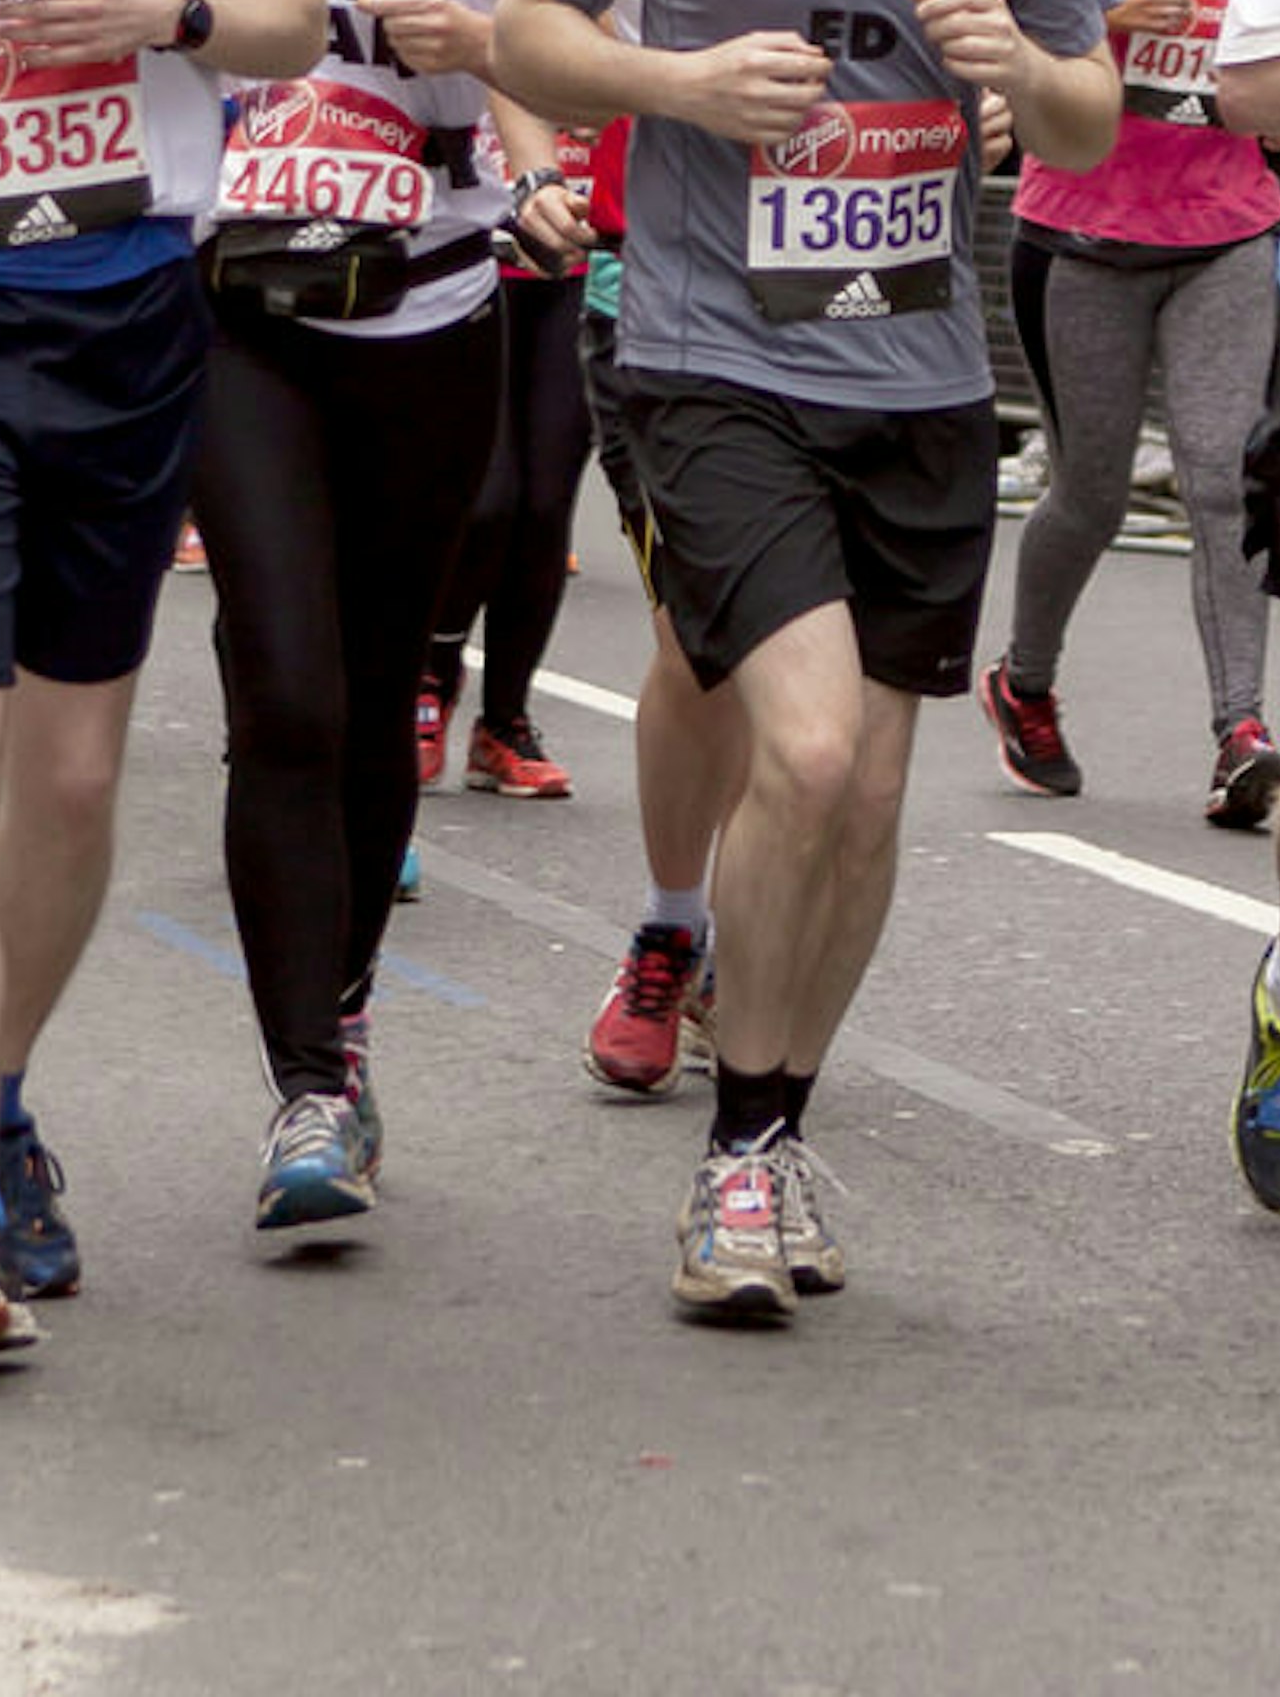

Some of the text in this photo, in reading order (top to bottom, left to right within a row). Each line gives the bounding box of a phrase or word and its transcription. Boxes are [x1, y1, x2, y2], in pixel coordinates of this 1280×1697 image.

[1132, 39, 1219, 84] 401
[320, 102, 417, 154] money
[859, 119, 960, 154] money
[226, 157, 424, 228] 44679
[759, 179, 944, 252] 13655
